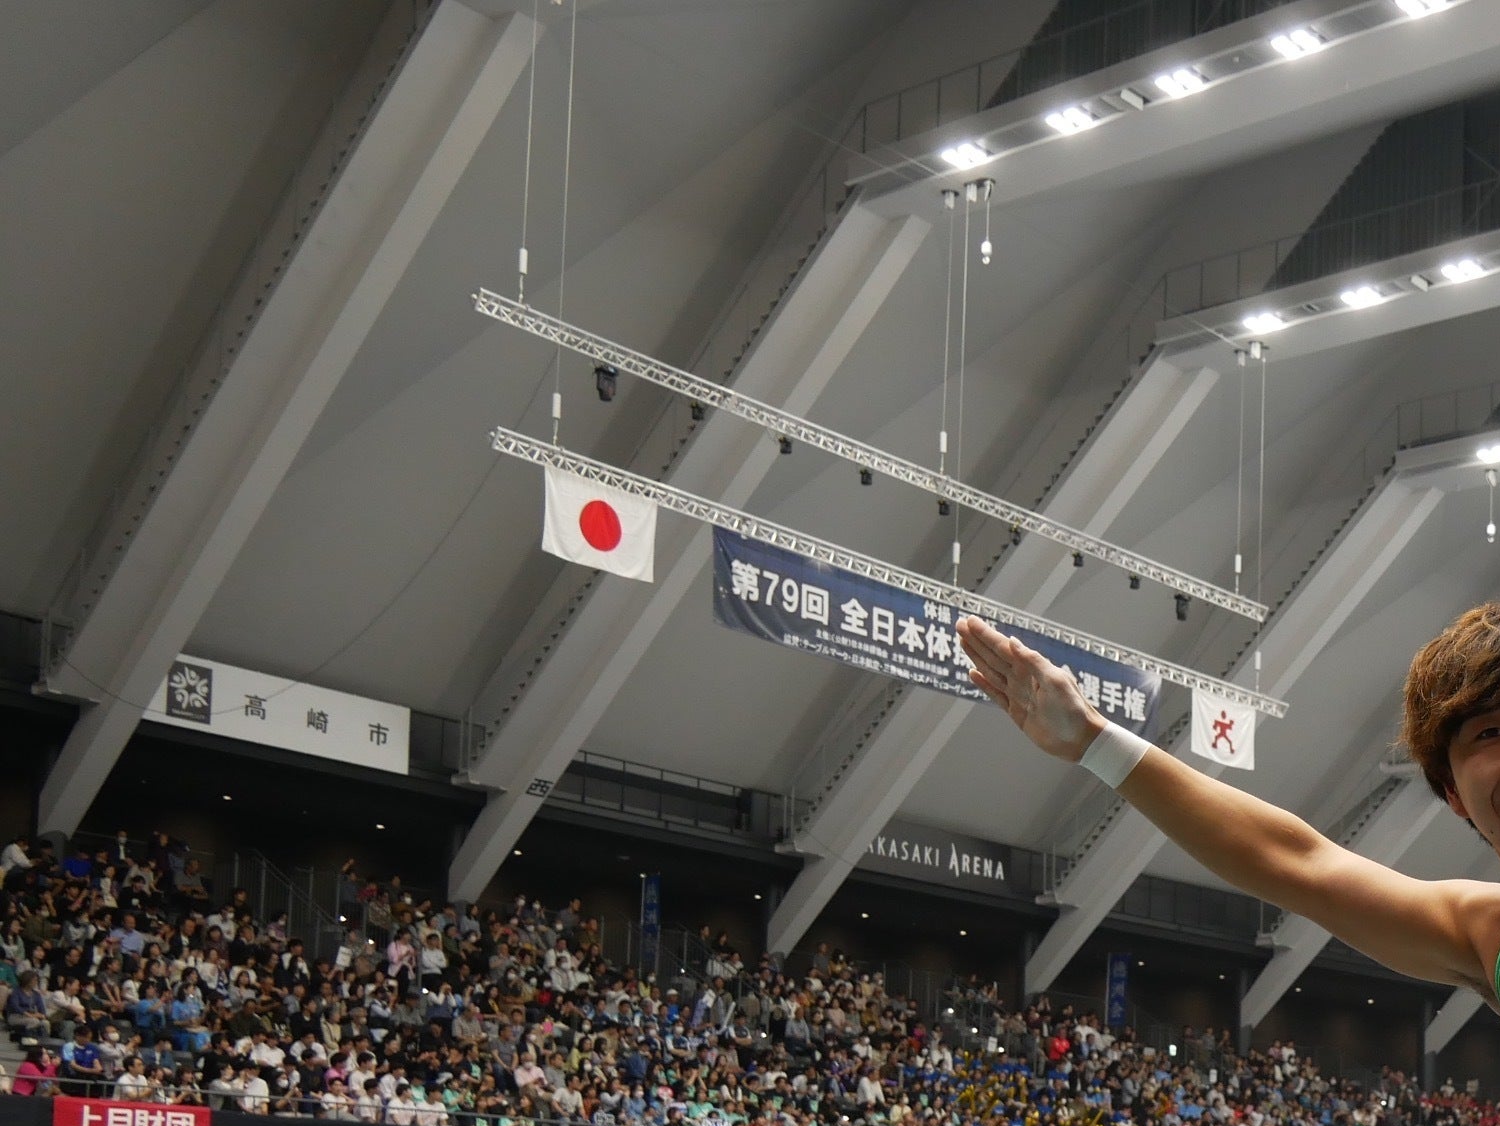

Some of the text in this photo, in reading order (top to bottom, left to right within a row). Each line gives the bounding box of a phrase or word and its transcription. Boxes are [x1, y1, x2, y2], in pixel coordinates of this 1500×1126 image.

[731, 559, 830, 626] 第79回
[923, 599, 951, 625] 体操
[244, 694, 390, 746] 高崎市
[869, 836, 1004, 880] KASAKI ARENA
